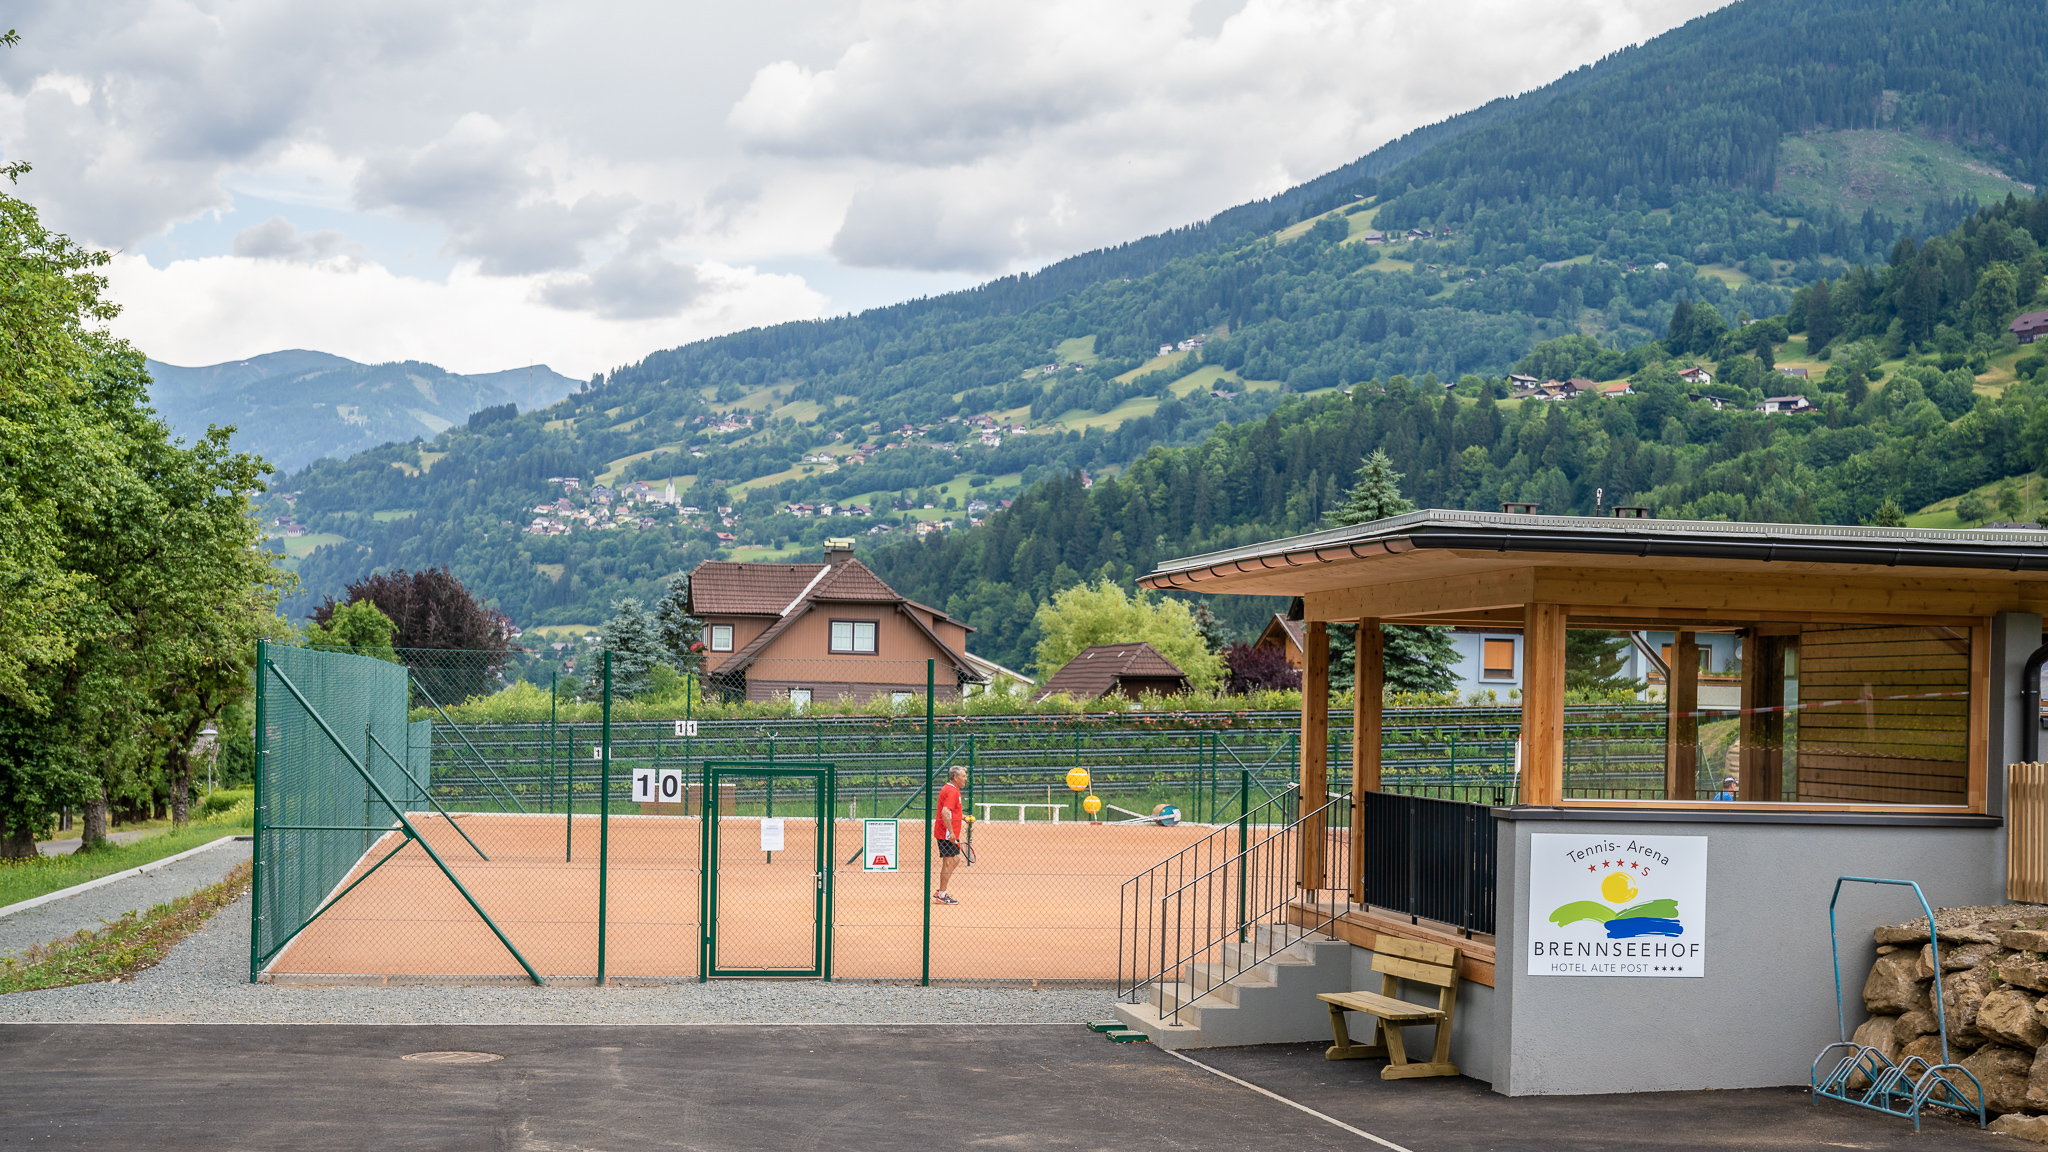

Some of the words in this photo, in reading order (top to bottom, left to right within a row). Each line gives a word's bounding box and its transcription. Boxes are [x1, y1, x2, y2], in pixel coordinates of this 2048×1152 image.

[637, 774, 678, 797] 10
[1566, 839, 1621, 864] Tennis-
[1626, 840, 1670, 866] Arena
[1534, 941, 1700, 957] BRENNSEEHOF
[1551, 963, 1587, 972] HOTEL
[1590, 963, 1616, 972] ALTE
[1620, 963, 1649, 973] POST
